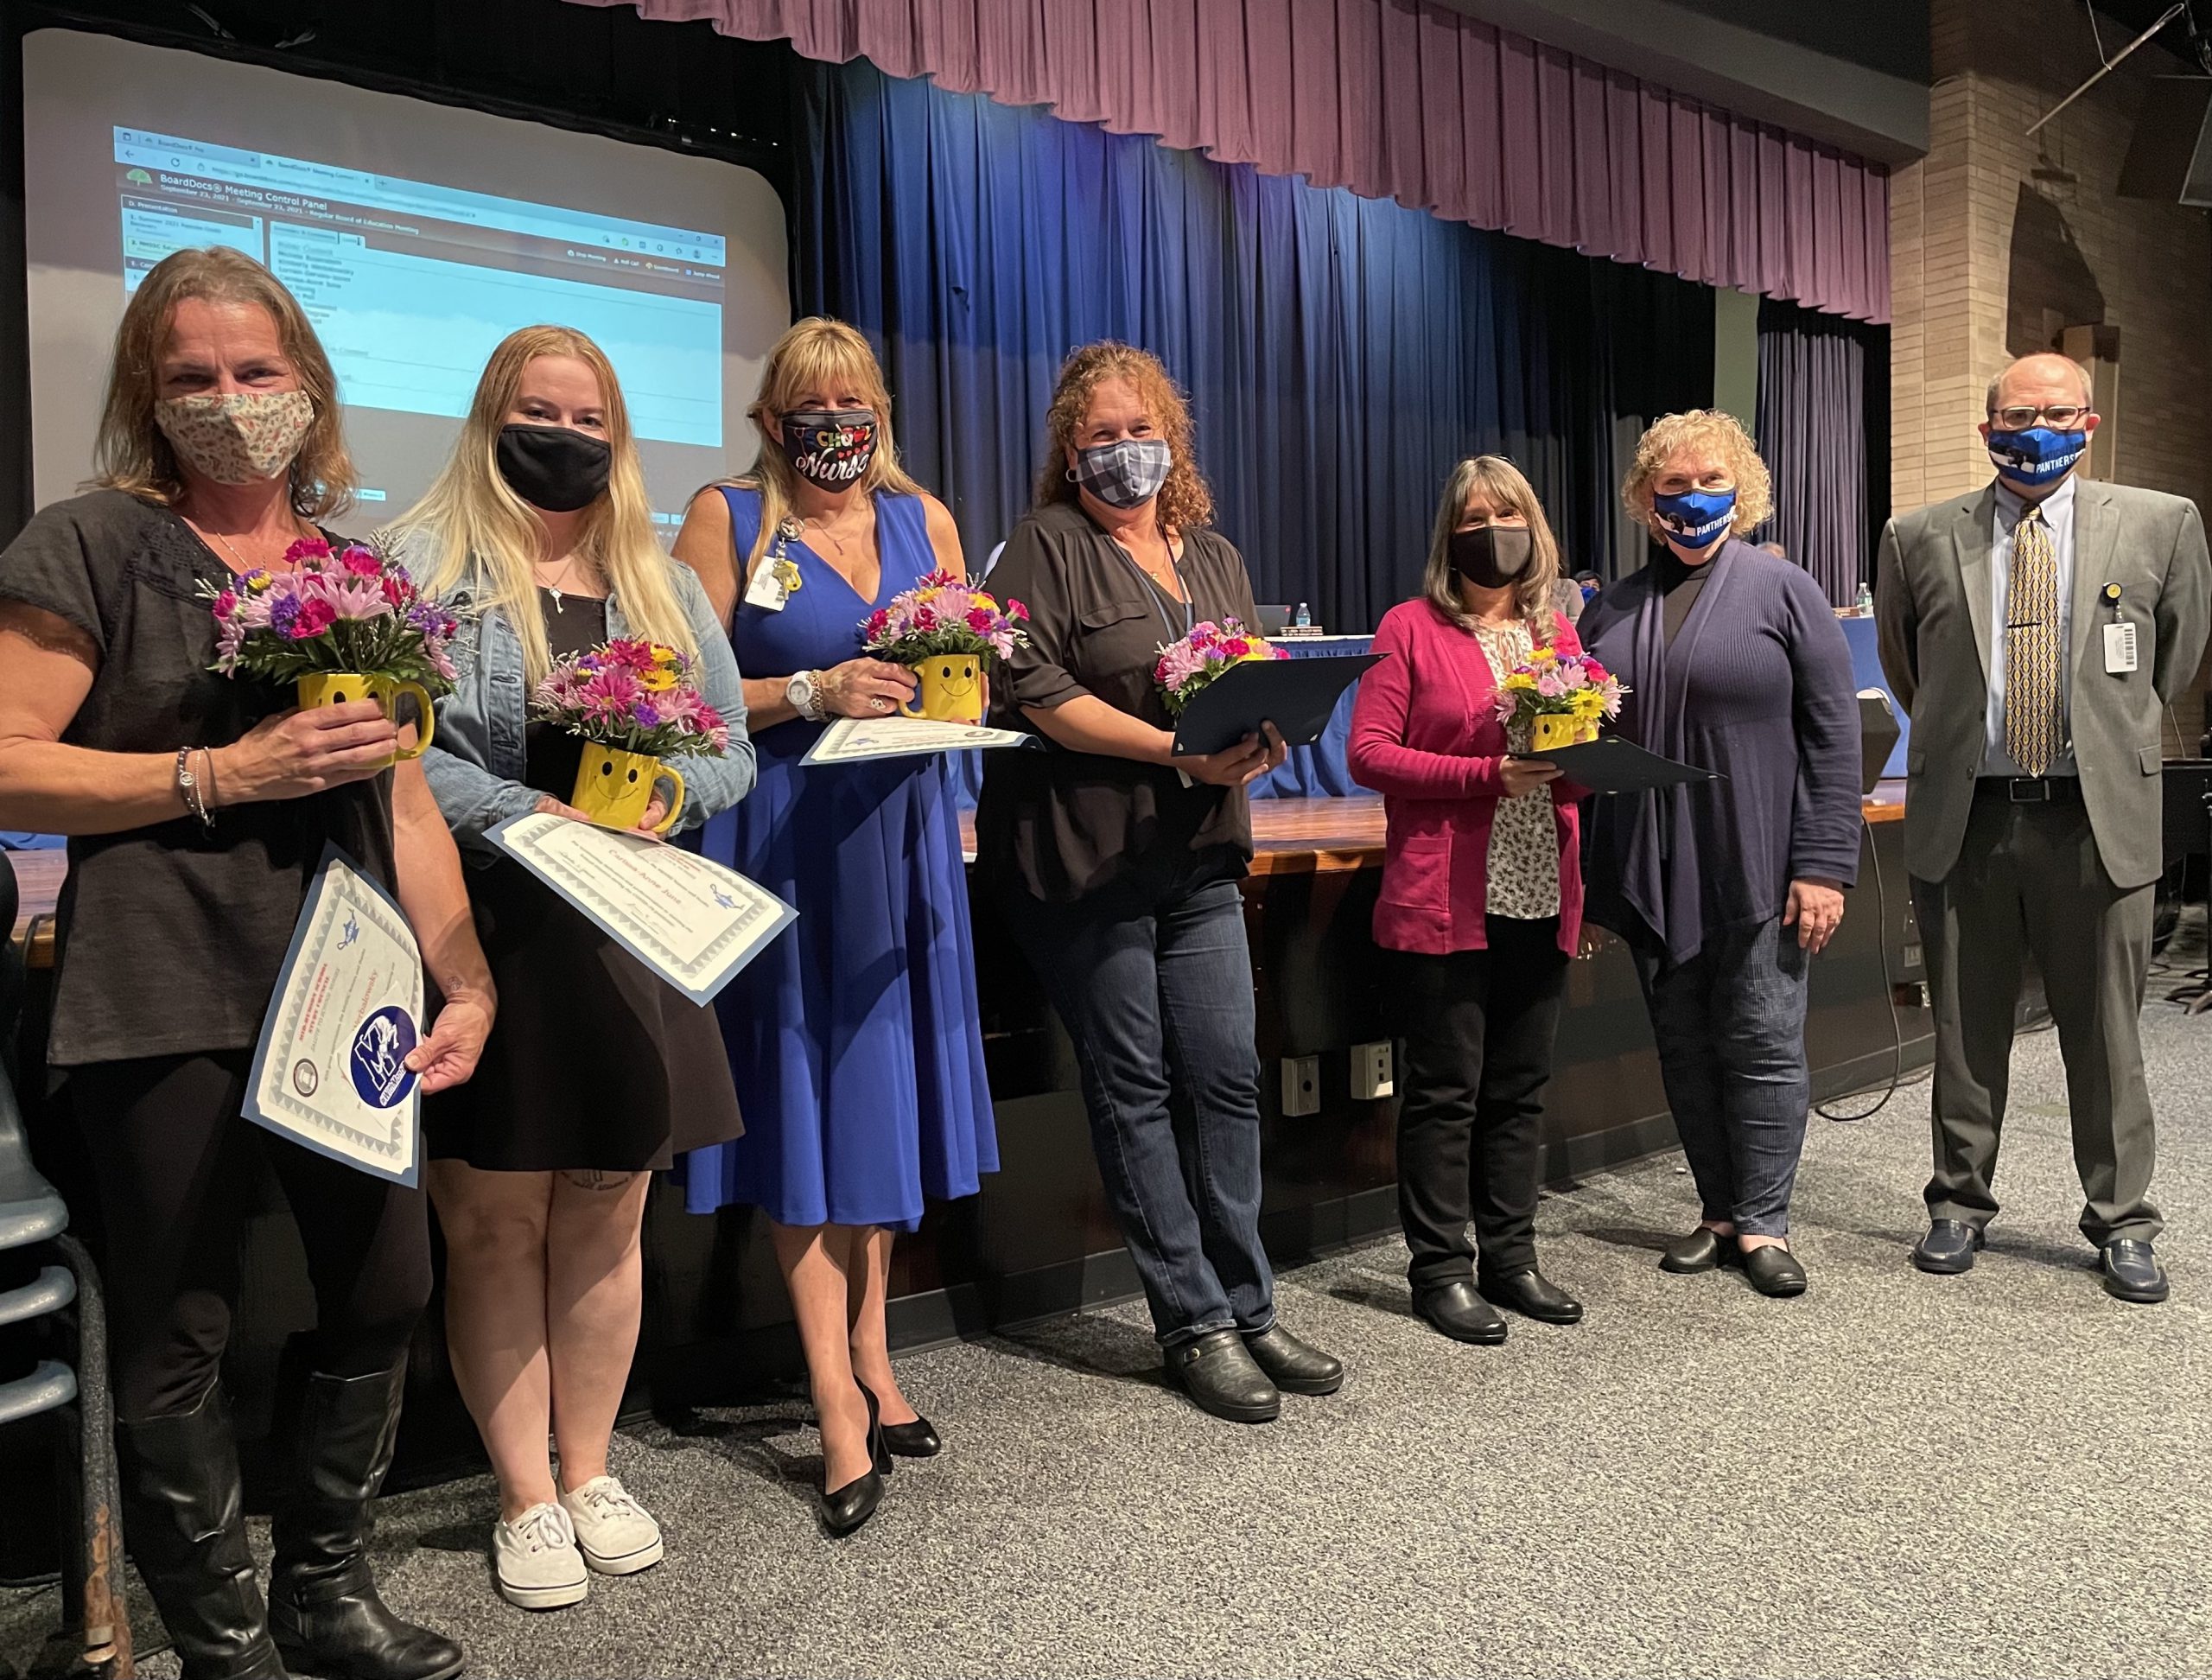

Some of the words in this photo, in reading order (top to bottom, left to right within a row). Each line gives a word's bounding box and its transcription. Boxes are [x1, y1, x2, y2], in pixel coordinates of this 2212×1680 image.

[161, 184, 197, 195] September
[213, 193, 229, 201] 2021
[237, 197, 272, 208] September
[287, 206, 302, 214] 2021
[309, 210, 334, 220] Regular
[335, 214, 354, 223] Board
[363, 219, 394, 230] Education
[395, 224, 419, 235] Meeting
[225, 185, 263, 200] Meeting
[265, 192, 300, 207] Control
[302, 199, 327, 211] Panel
[796, 447, 869, 481] Nurse
[2036, 454, 2075, 474] PANTHERS
[1696, 512, 1732, 537] PANTHERS
[659, 887, 683, 906] June
[353, 1024, 397, 1091] M
